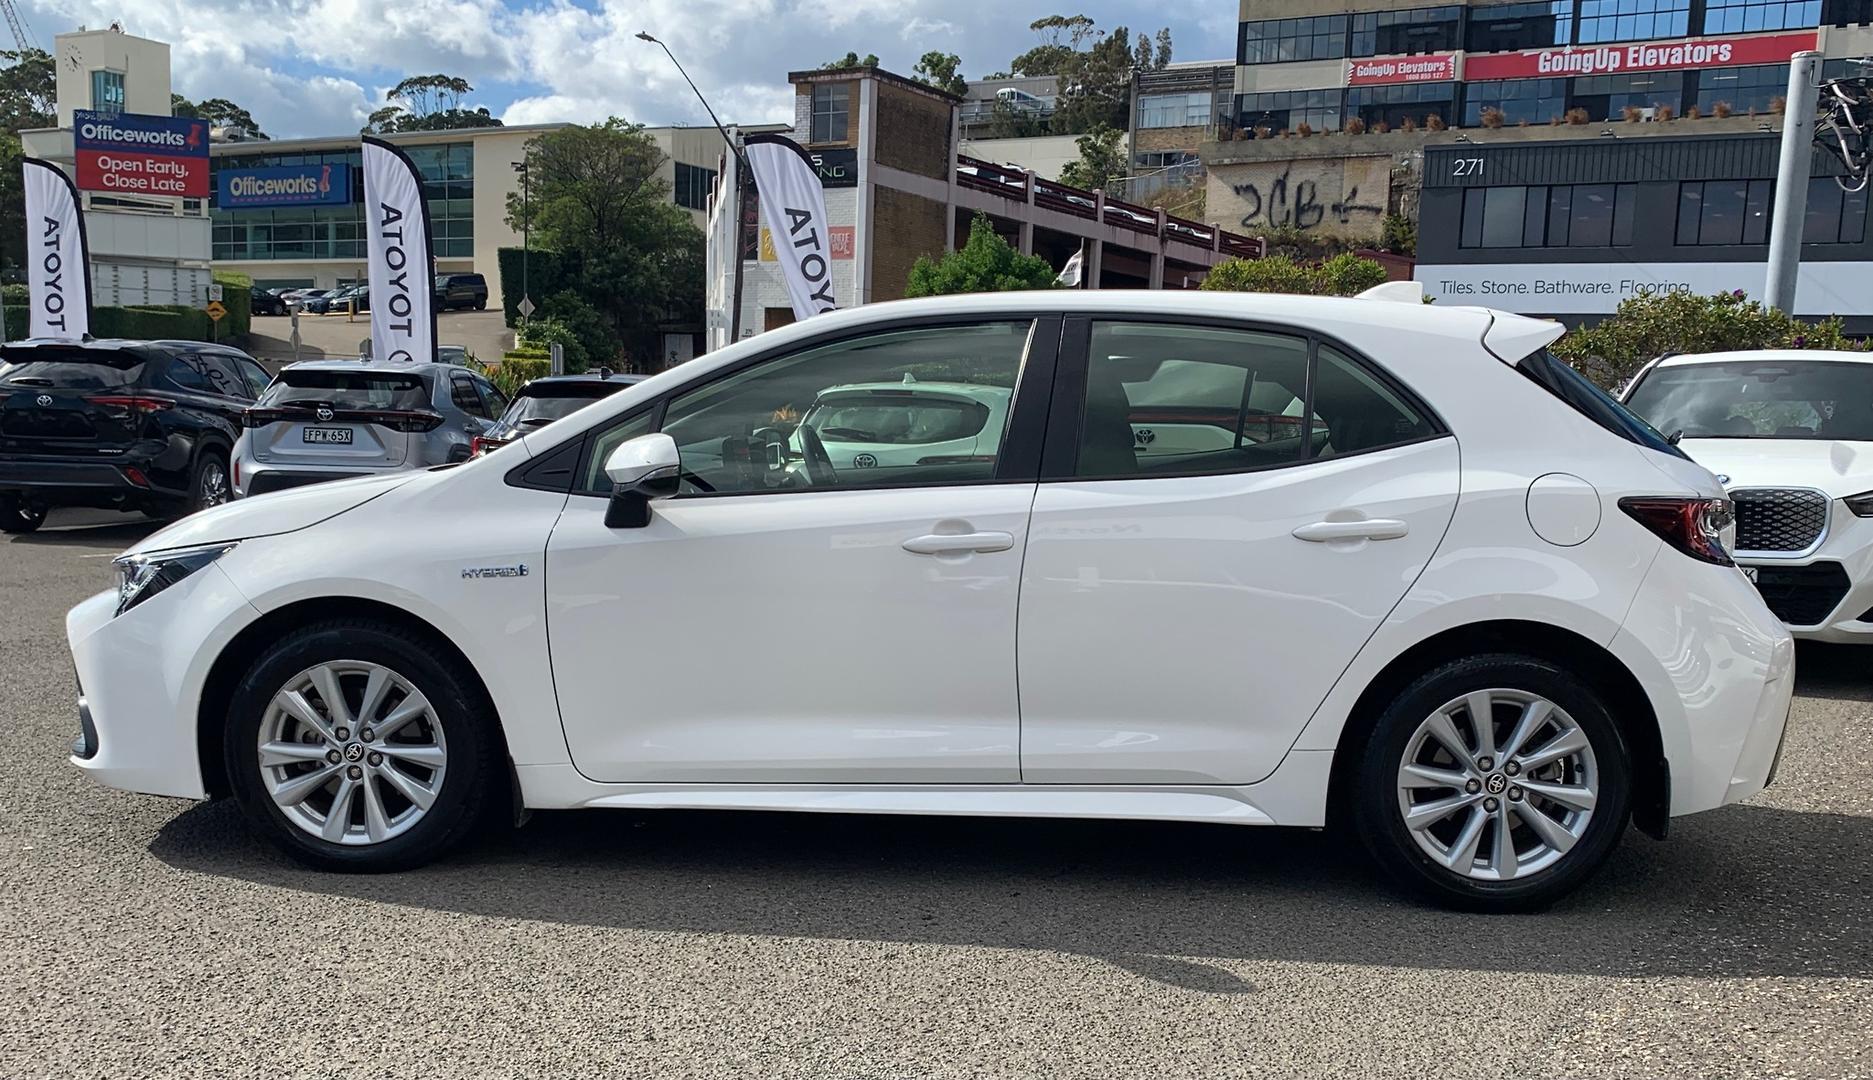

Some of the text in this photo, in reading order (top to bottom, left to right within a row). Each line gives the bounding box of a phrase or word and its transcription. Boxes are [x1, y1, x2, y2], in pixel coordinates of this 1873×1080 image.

[1538, 43, 1732, 73] GoingUp Elevators
[1356, 61, 1446, 77] GoingUp Elevators
[81, 123, 185, 146] Officeworks
[97, 155, 189, 178] Open Early,
[1453, 158, 1484, 176] 271
[102, 172, 186, 191] Close Late
[229, 173, 317, 196] Officeworks
[1440, 280, 1477, 294] Tiles.
[1481, 280, 1530, 295] Stone.
[1534, 279, 1615, 294] Bathware.
